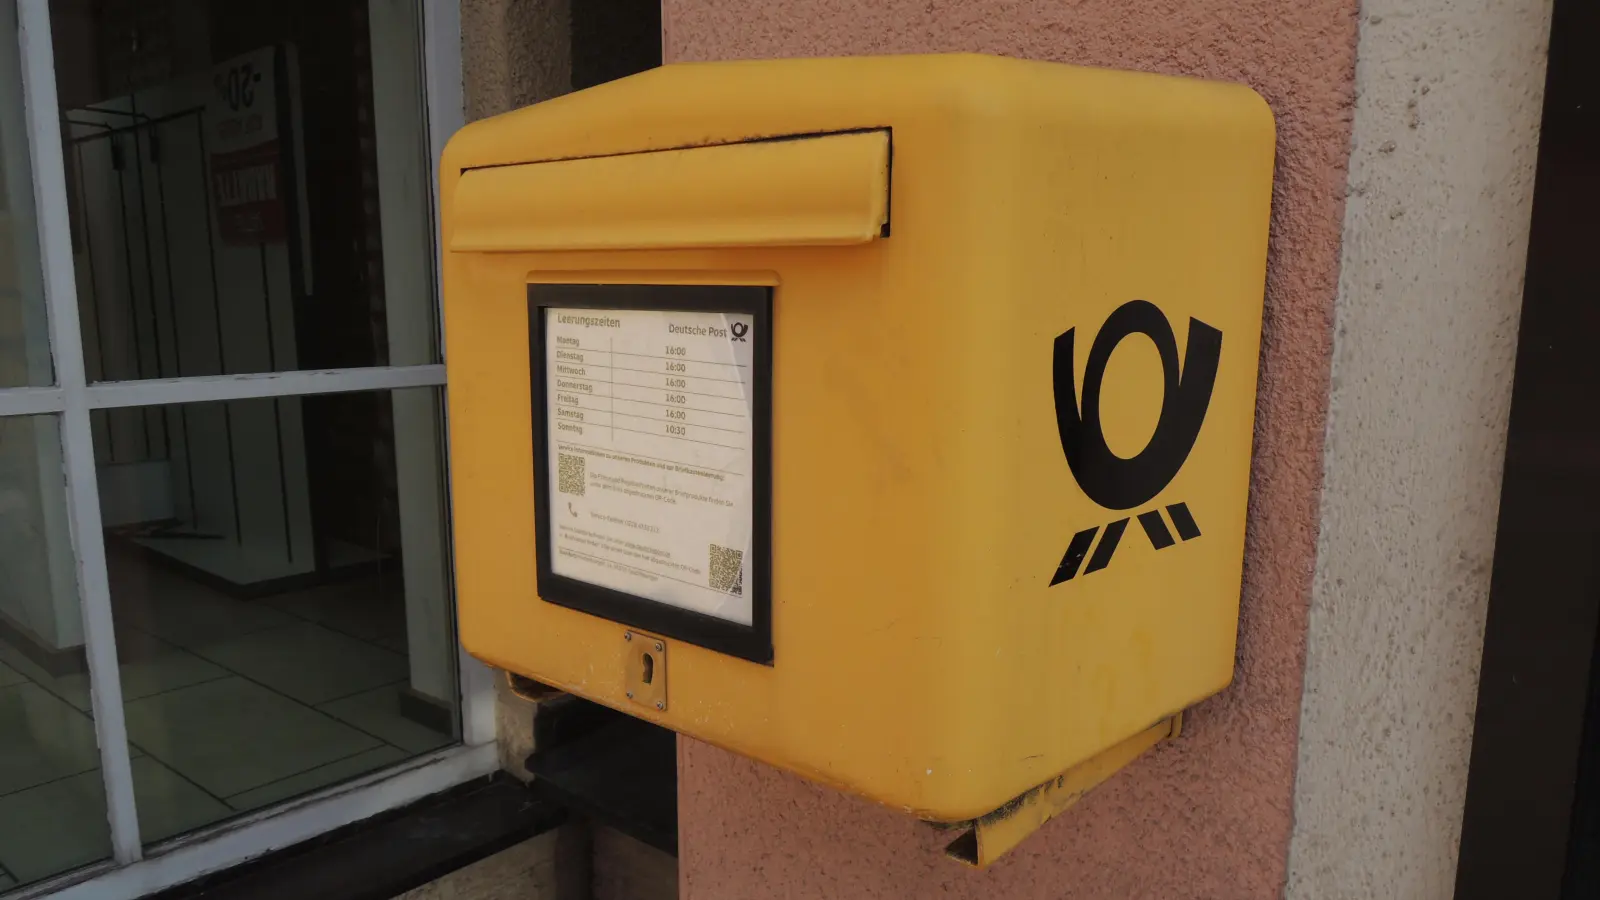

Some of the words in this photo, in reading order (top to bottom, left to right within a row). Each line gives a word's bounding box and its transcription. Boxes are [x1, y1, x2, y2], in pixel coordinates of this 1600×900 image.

[557, 312, 621, 328] Leerungszeiten
[668, 323, 707, 336] Deutsche
[708, 327, 728, 338] Post
[556, 336, 580, 347] Montag
[556, 350, 584, 362] Dienstag
[665, 346, 686, 356] 16:00
[556, 365, 586, 376] Mittwoch
[665, 362, 686, 372] 16:00
[557, 379, 593, 393] Donnerstag
[665, 378, 686, 388] 16:00
[557, 394, 579, 405] Freitag
[665, 394, 686, 404] 16:00
[557, 408, 584, 420] Samstag
[665, 410, 686, 420] 16:00
[557, 422, 583, 435] Sonntag
[665, 425, 686, 436] 10:30
